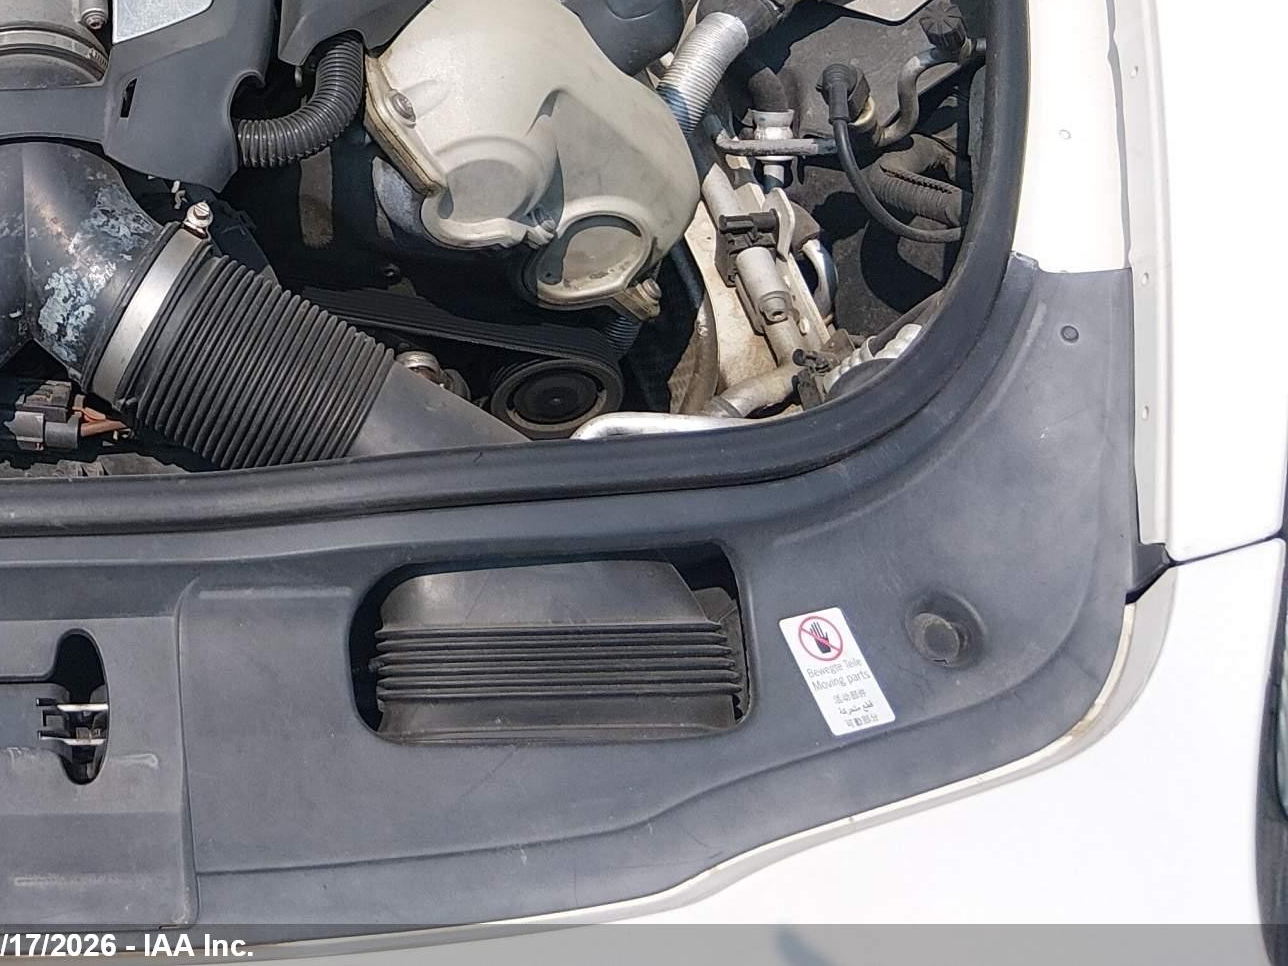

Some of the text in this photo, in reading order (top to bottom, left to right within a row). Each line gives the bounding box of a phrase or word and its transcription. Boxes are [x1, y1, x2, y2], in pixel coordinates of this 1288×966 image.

[806, 658, 863, 678] Bewegte Teile
[812, 671, 871, 691] Moving parts
